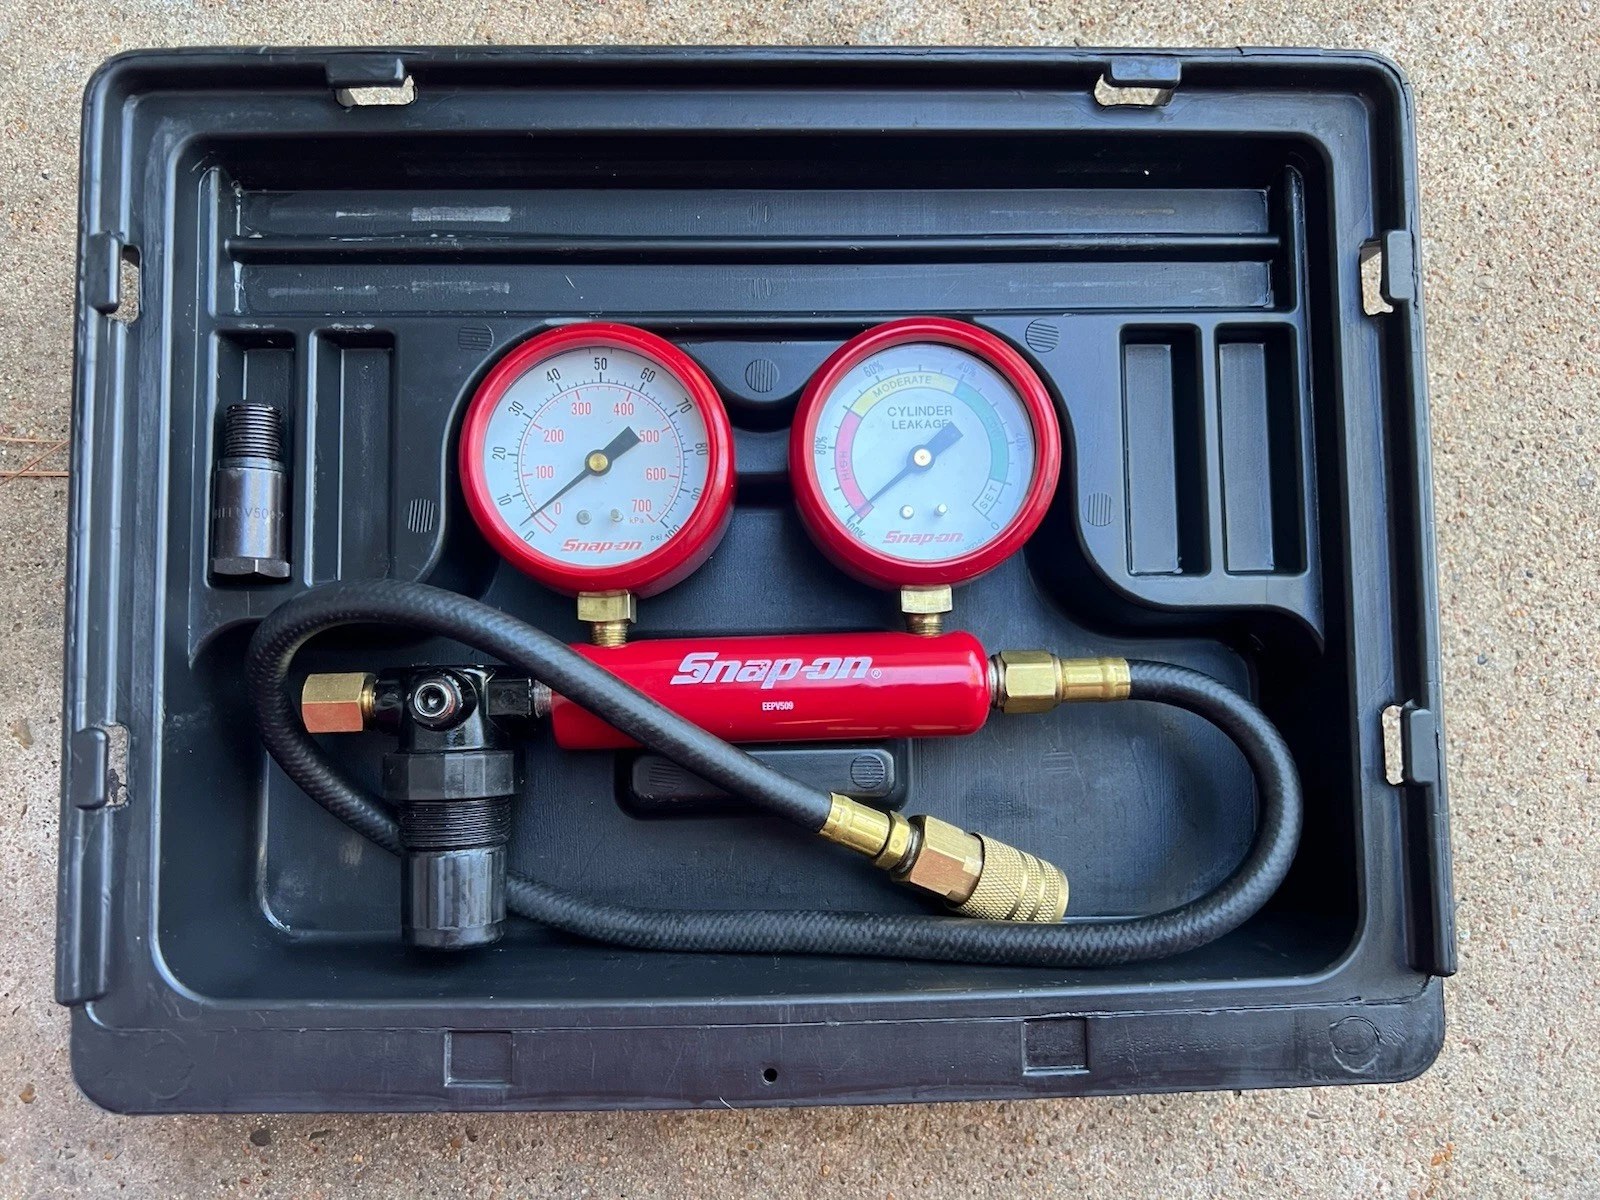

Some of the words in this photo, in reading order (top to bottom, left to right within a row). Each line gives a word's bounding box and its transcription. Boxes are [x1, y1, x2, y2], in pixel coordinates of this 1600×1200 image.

[594, 358, 607, 369] 50
[864, 361, 884, 377] 60%
[547, 369, 561, 382] 40
[640, 368, 656, 382] 60
[873, 376, 931, 397] MODERATE
[508, 401, 524, 416] 30
[571, 403, 591, 415] 300
[613, 403, 634, 415] 400
[676, 398, 692, 414] 70
[887, 405, 953, 416] CYLINDER
[891, 418, 949, 429] LEAKAGE
[544, 430, 564, 442] 200
[639, 430, 659, 442] 500
[695, 443, 708, 456] 80
[815, 436, 828, 455] 80%
[492, 446, 505, 460] 20
[536, 467, 553, 478] 100
[646, 468, 666, 480] 600
[497, 494, 511, 506] 10
[981, 485, 997, 509] SET
[555, 503, 561, 514] 0
[632, 499, 651, 512] 700
[991, 522, 999, 530] 0
[525, 531, 534, 541] 0
[650, 534, 662, 542] psi
[882, 530, 963, 545] Snap-on
[561, 539, 642, 553] Snap-on
[762, 702, 794, 711] EEPV509
